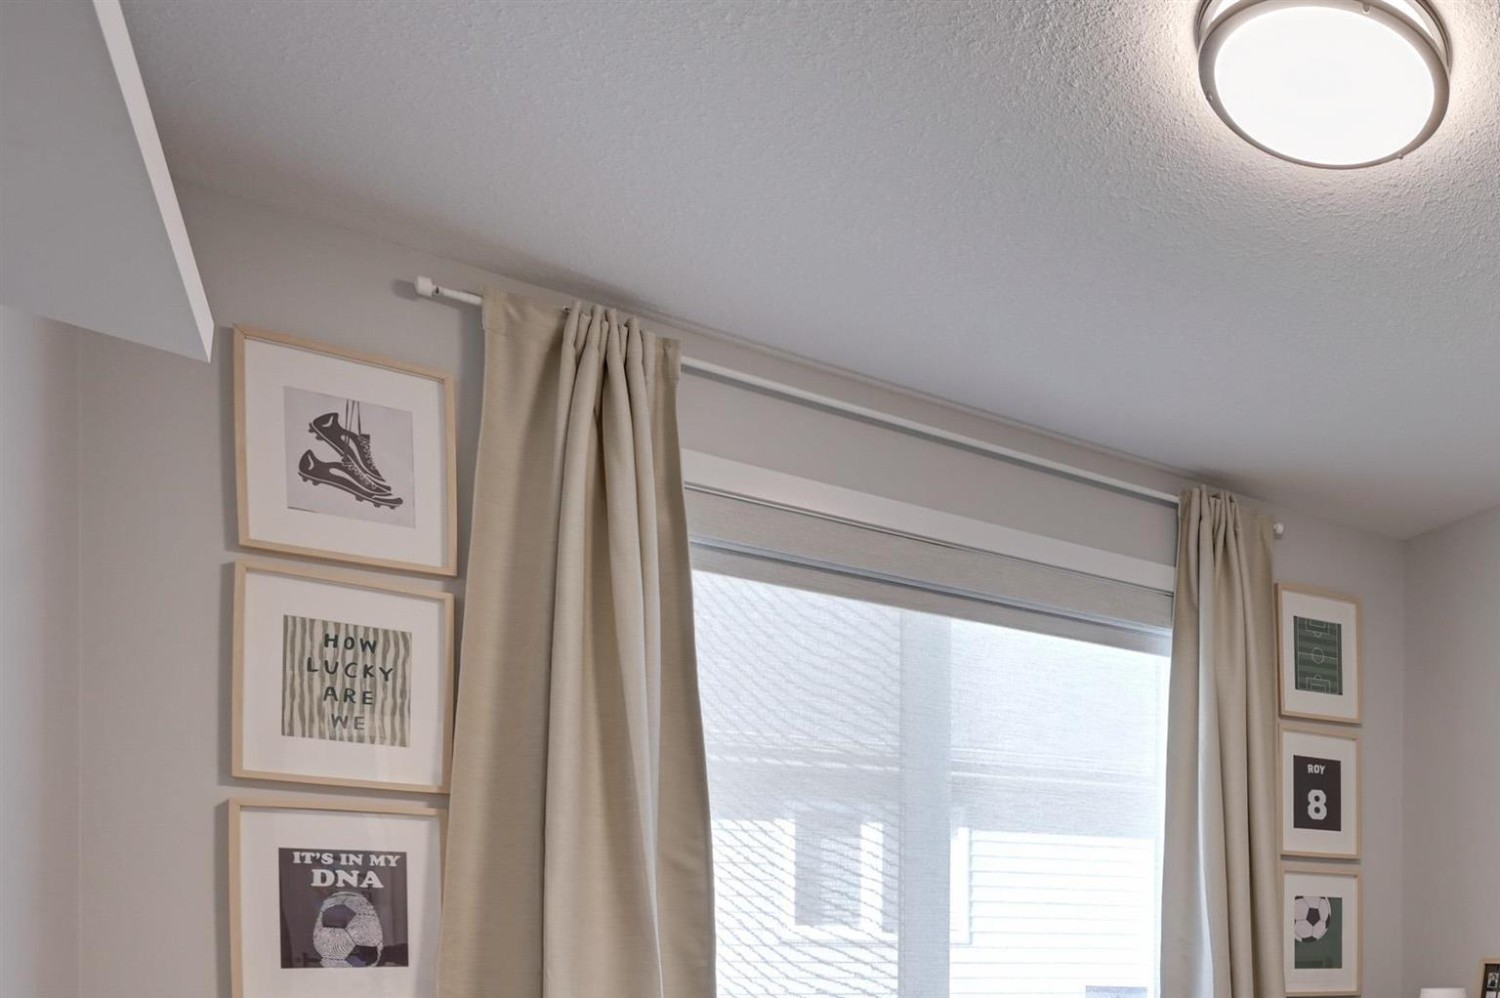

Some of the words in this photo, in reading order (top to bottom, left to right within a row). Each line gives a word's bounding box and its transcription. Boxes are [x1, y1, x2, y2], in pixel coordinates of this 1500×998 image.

[323, 633, 377, 654] HOW
[306, 657, 393, 682] LUCKY
[323, 686, 374, 705] ARE
[331, 714, 365, 730] WE
[1307, 764, 1326, 775] ROY
[1307, 789, 1327, 820] 8
[292, 851, 334, 865] IT'S
[340, 853, 364, 865] IN
[369, 854, 401, 867] MY
[310, 869, 384, 888] DNA
